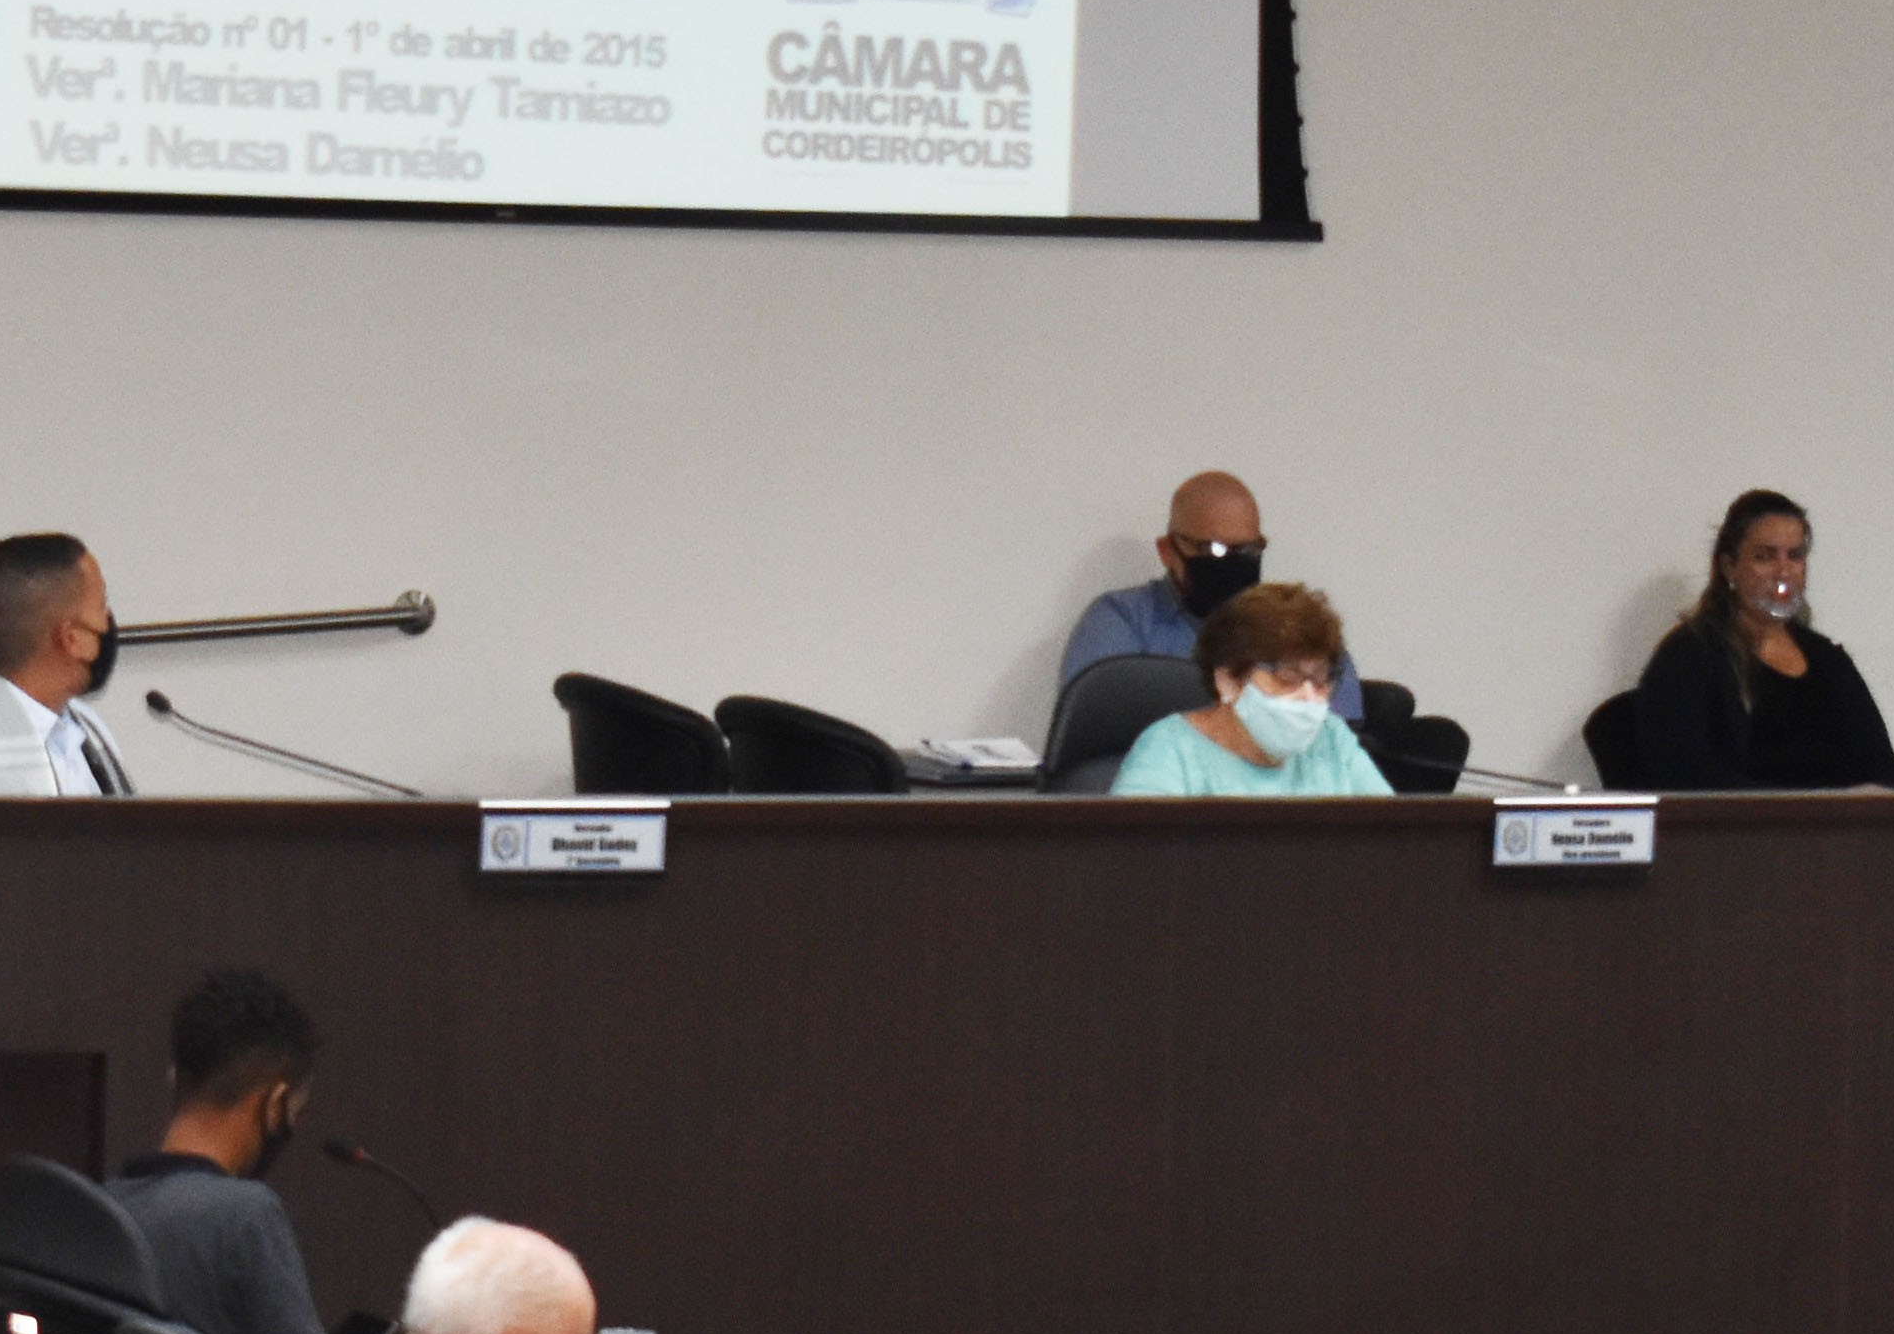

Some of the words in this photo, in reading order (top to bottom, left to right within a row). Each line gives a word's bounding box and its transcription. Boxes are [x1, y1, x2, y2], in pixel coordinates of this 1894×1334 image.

[30, 5, 210, 49] Resolução
[268, 15, 309, 51] 01
[389, 21, 433, 58] de
[445, 25, 516, 62] abril
[528, 28, 570, 65] de
[583, 31, 667, 69] 2015
[766, 19, 1032, 95] CÂMARA
[141, 61, 321, 111] Mariana
[337, 66, 474, 128] Fleury
[488, 74, 672, 126] Tamiazo
[765, 88, 970, 130] MUNICIPAL
[982, 99, 1032, 132] DE
[146, 126, 290, 174] Neusa
[305, 130, 486, 182] Damélio
[762, 128, 1033, 170] CORDEIRÓPOLIS
